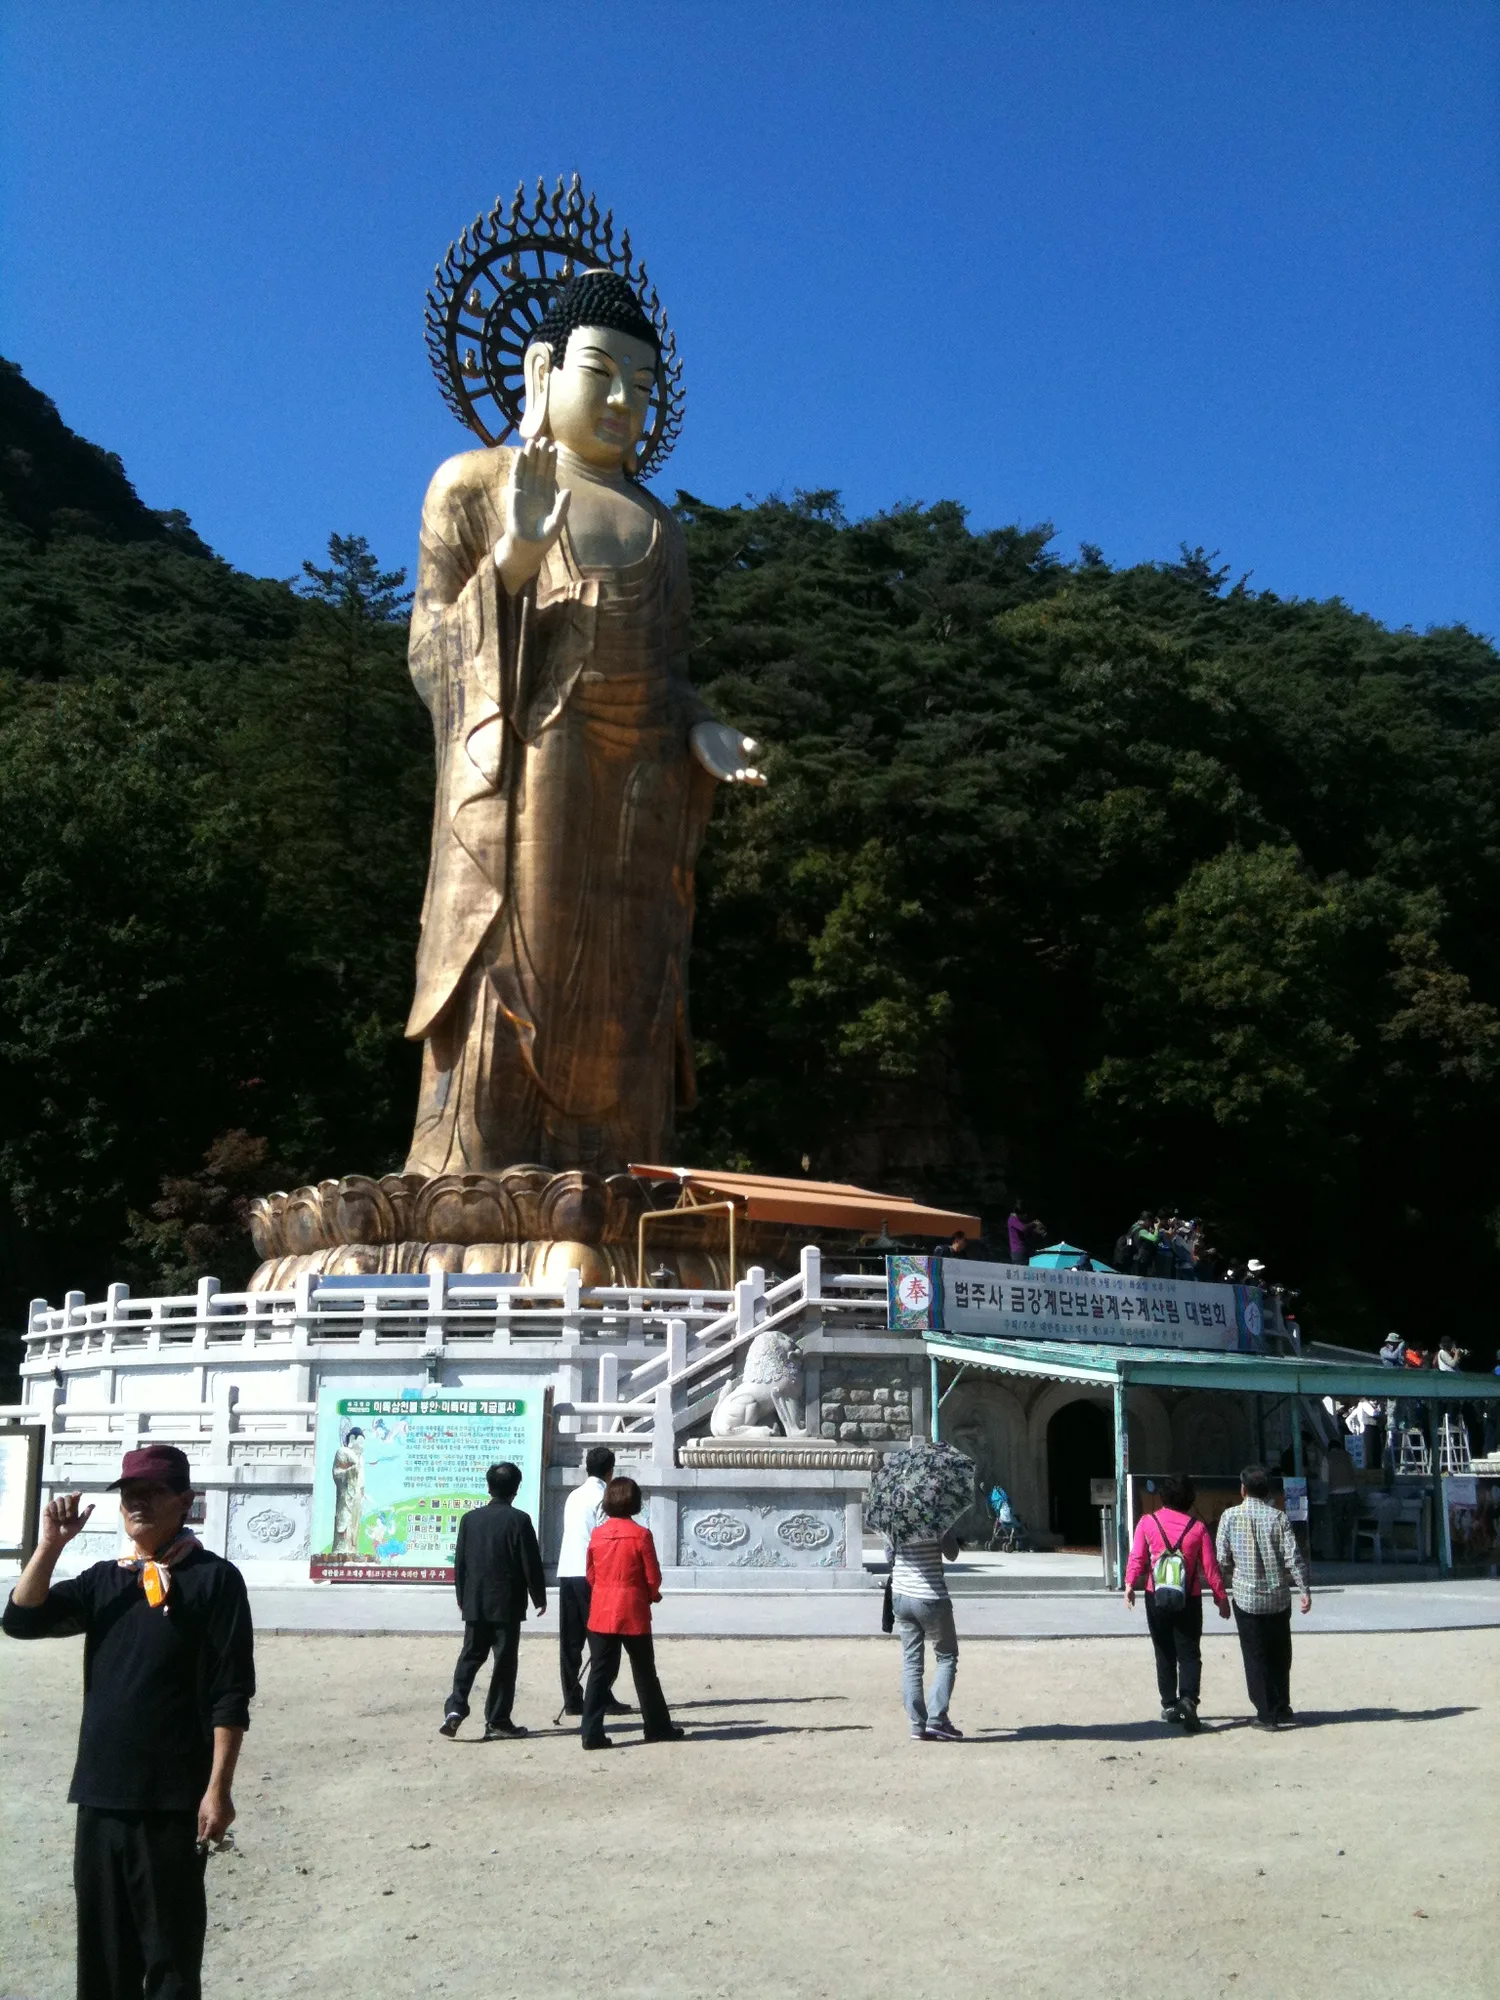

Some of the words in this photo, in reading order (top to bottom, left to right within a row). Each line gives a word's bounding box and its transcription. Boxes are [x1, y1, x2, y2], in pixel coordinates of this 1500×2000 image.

[905, 1277, 930, 1304] 奉
[954, 1281, 1003, 1311] 법주사
[1184, 1300, 1227, 1327] 대법회
